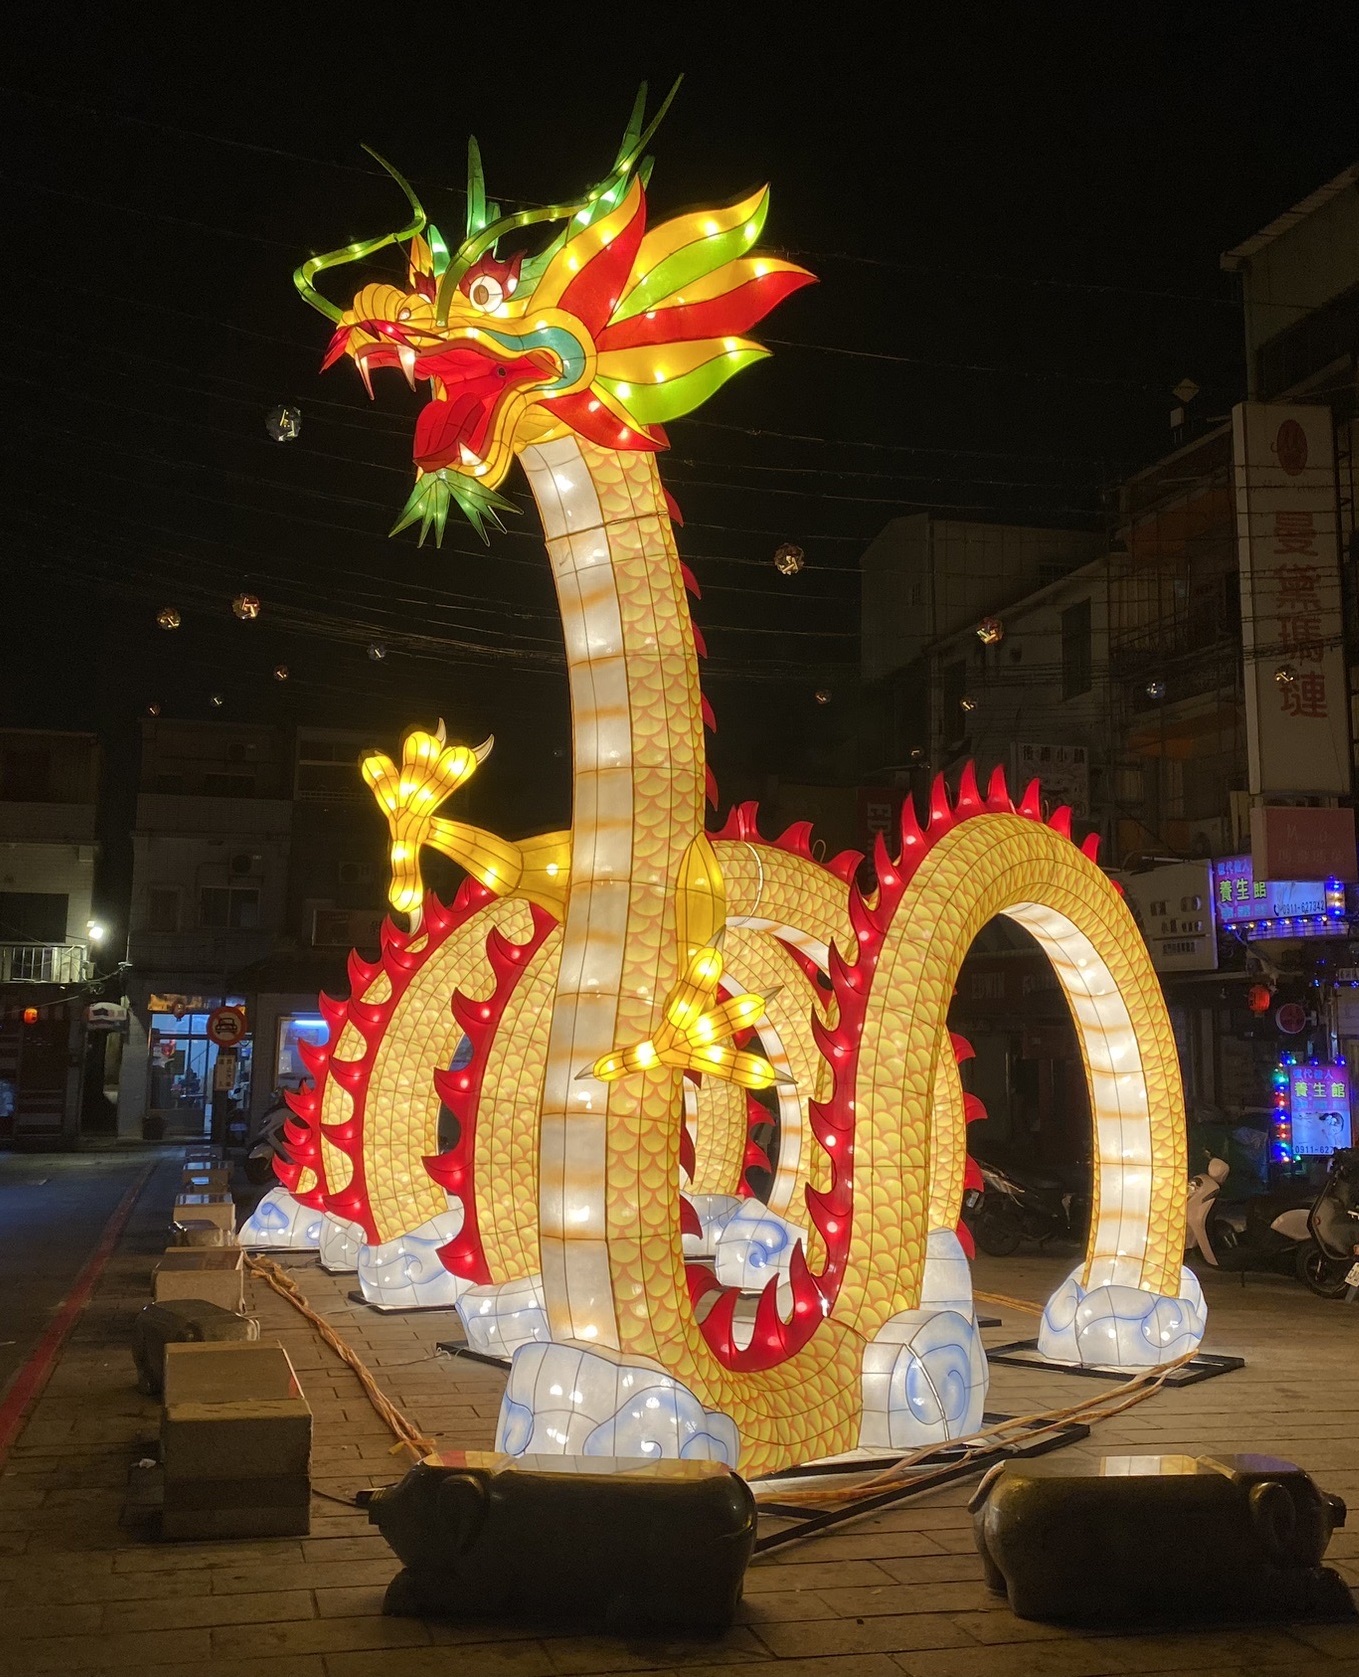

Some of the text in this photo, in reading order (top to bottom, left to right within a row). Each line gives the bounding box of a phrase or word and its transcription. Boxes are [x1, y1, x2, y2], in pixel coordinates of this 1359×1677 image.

[1273, 511, 1328, 718] 曼黛瑪璉
[1219, 878, 1267, 902] 養生館
[1282, 900, 1325, 915] 0911-627342
[1294, 1082, 1346, 1098] 養生館
